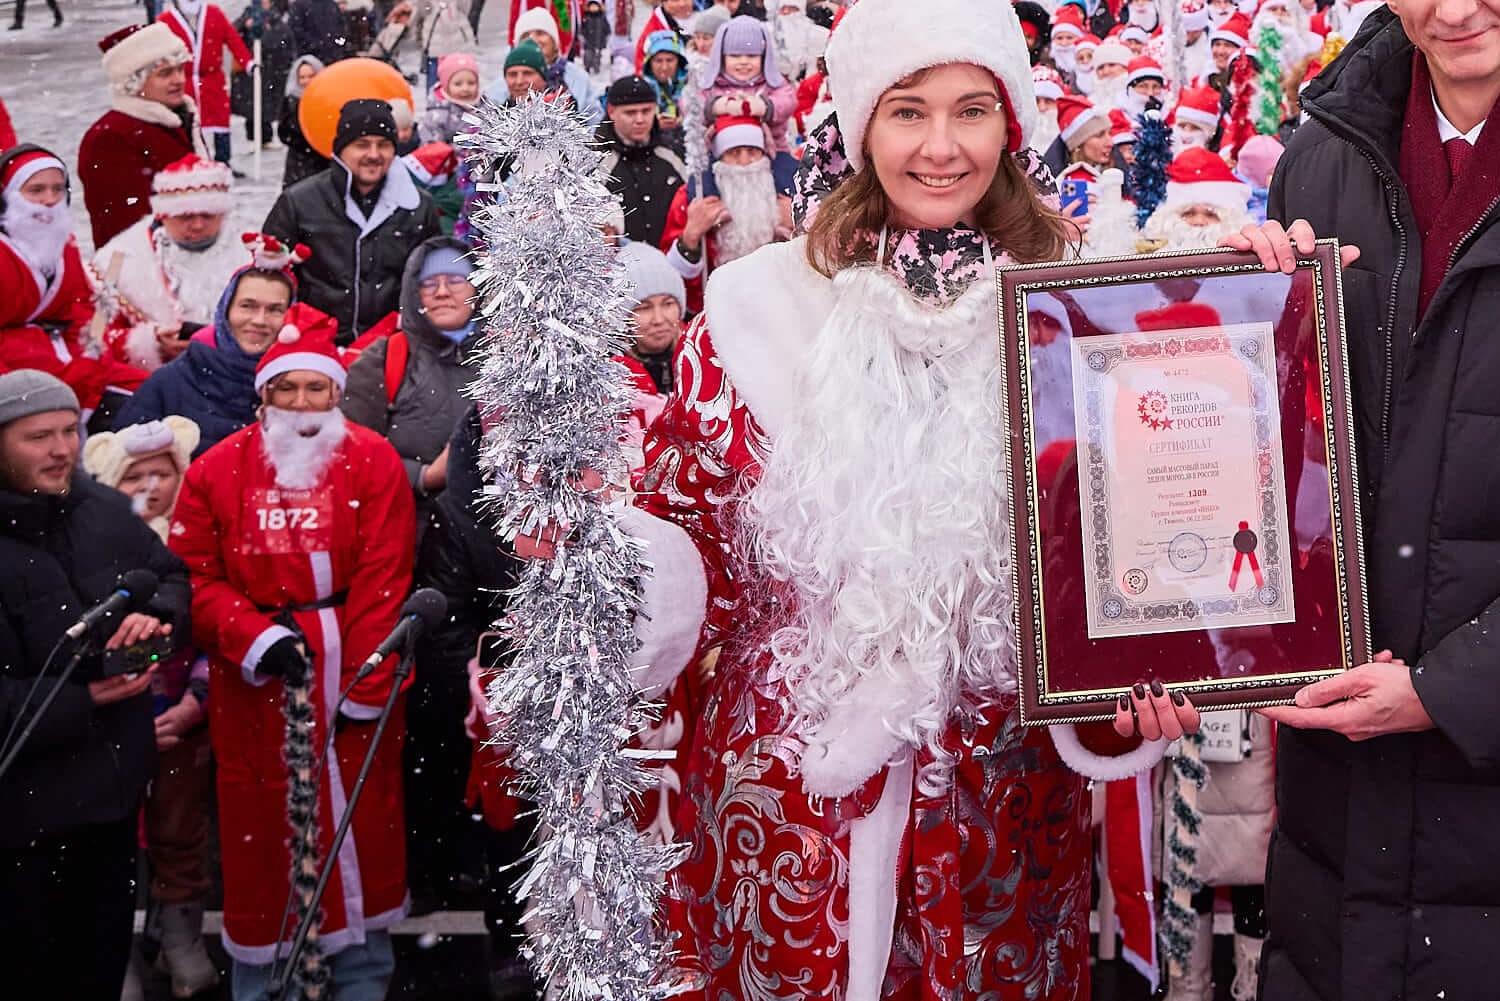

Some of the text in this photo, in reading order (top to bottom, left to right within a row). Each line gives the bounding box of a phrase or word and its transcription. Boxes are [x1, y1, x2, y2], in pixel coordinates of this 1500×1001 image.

[1170, 391, 1200, 403] КНИГА
[1171, 402, 1217, 416] РЕКОРДОВ
[1149, 439, 1213, 454] СЕРТИФИКАТ
[256, 507, 319, 531] 1872
